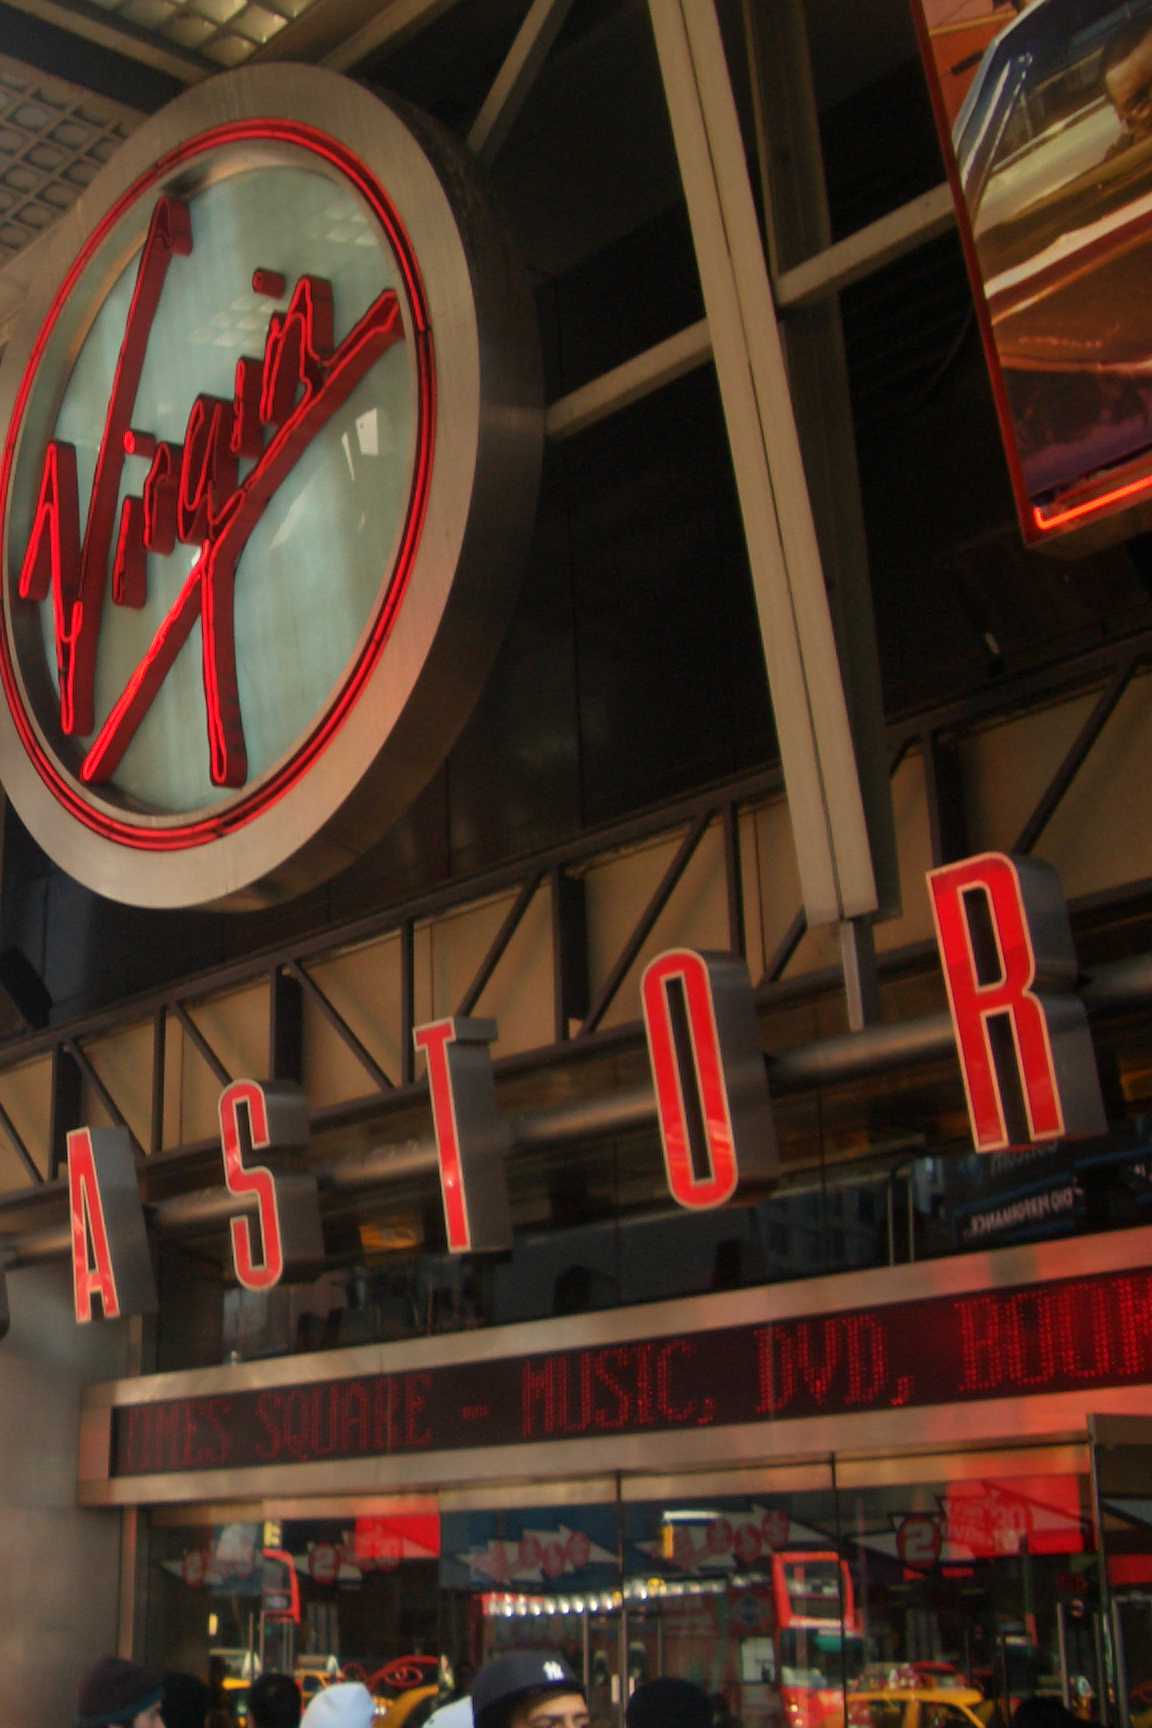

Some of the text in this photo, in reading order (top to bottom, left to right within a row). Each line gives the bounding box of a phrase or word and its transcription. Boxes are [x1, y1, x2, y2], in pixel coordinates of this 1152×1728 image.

[19, 197, 405, 787] Virgin
[254, 1373, 434, 1463] SQUARE
[520, 1339, 716, 1437] MUSIC,
[754, 1314, 914, 1414] DVD,
